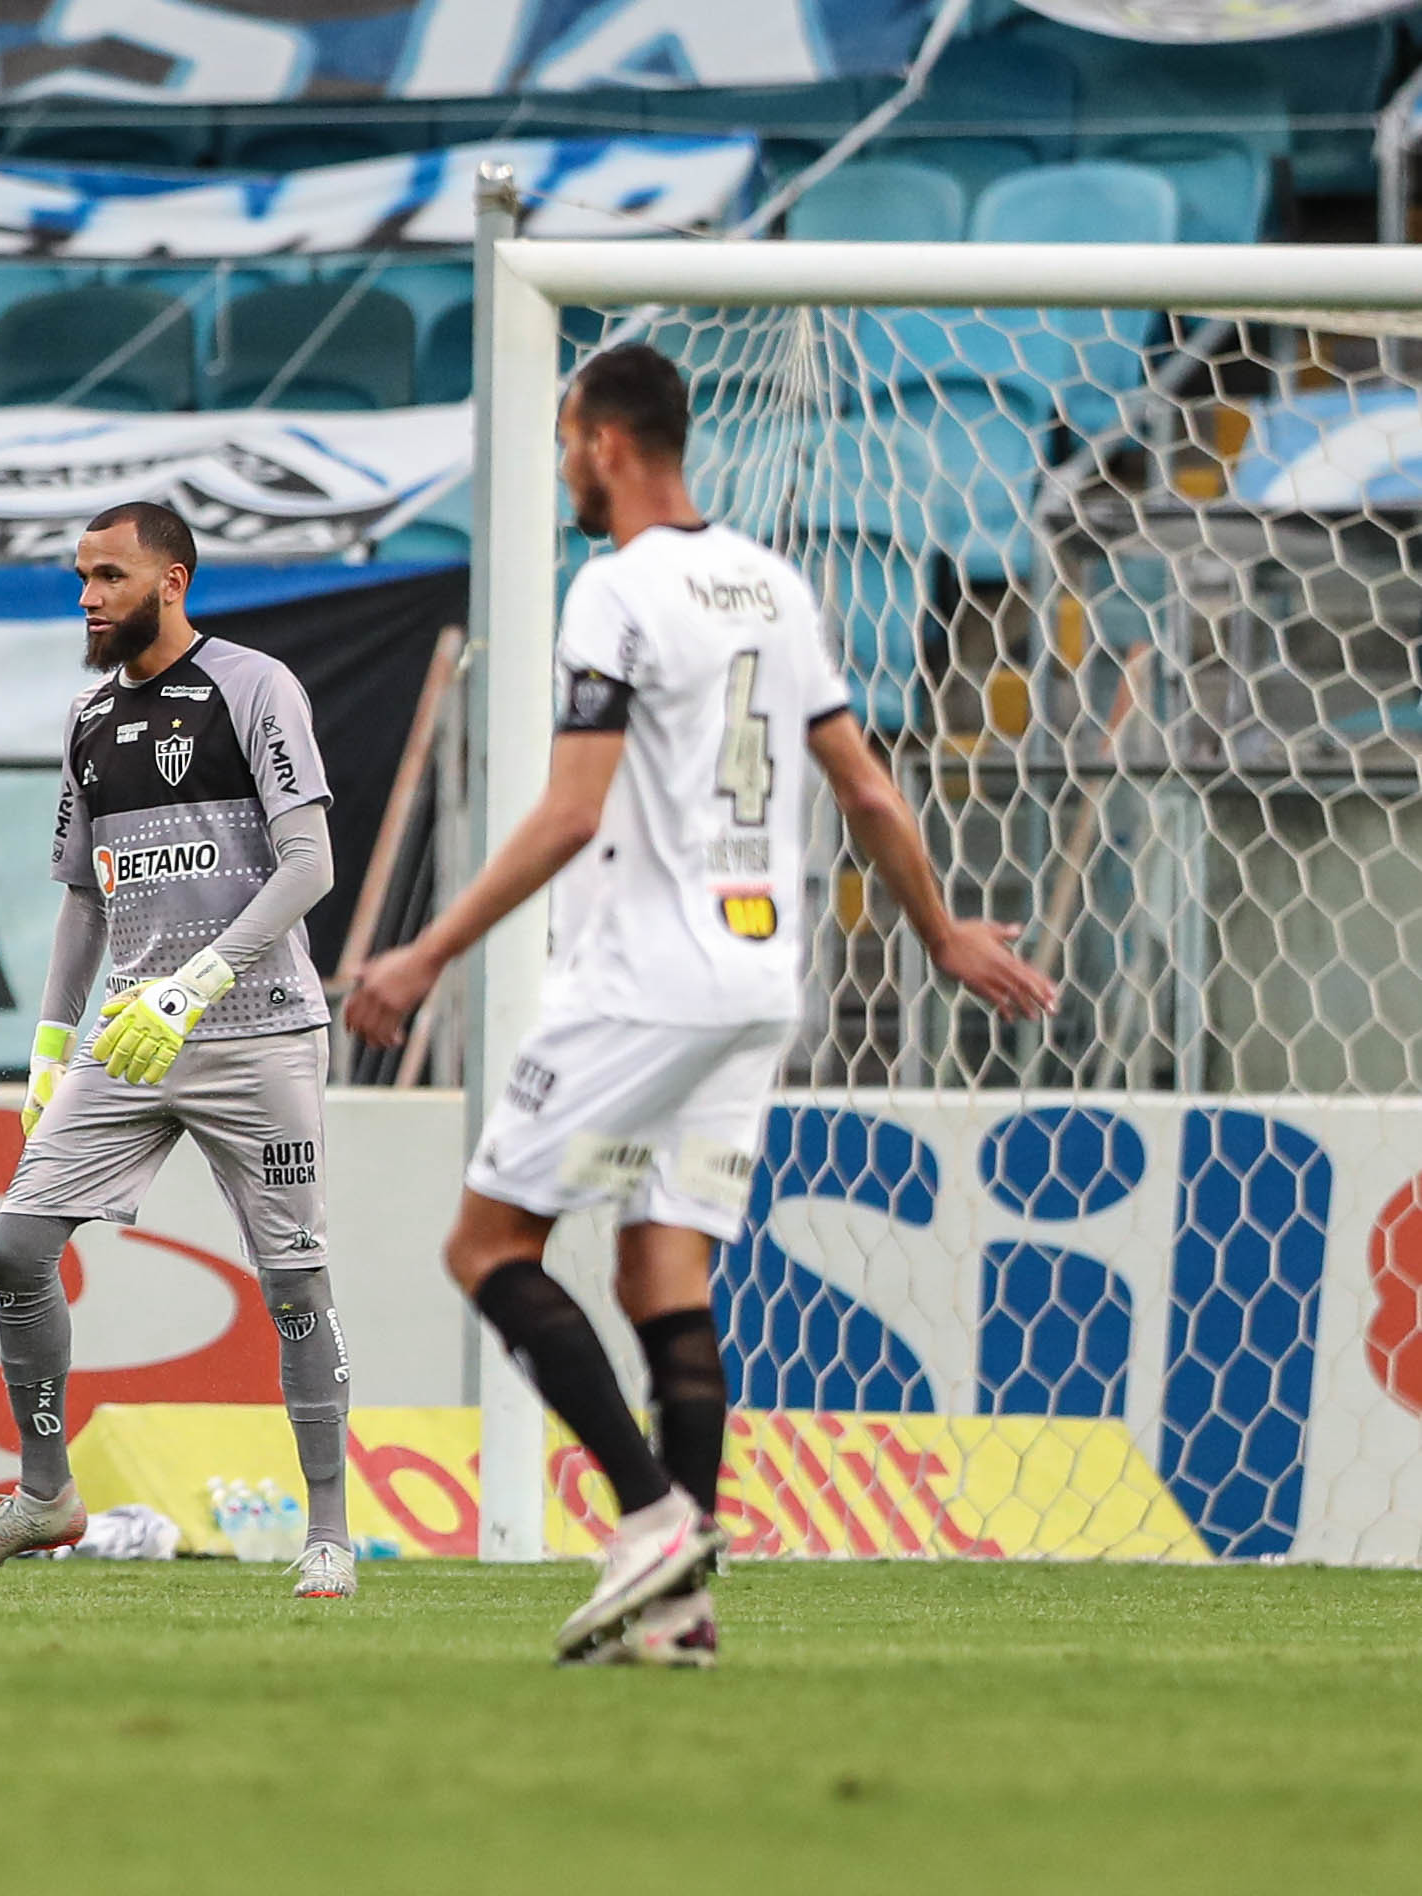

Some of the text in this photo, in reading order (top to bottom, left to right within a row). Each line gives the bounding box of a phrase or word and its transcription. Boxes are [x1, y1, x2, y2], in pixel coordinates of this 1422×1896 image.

[160, 741, 188, 753] CAM
[714, 648, 774, 827] 4
[268, 740, 300, 796] MRV
[55, 781, 75, 840] MRV
[118, 844, 216, 881] BETANO
[262, 1141, 316, 1166] AUTO
[263, 1165, 316, 1186] TRUCK
